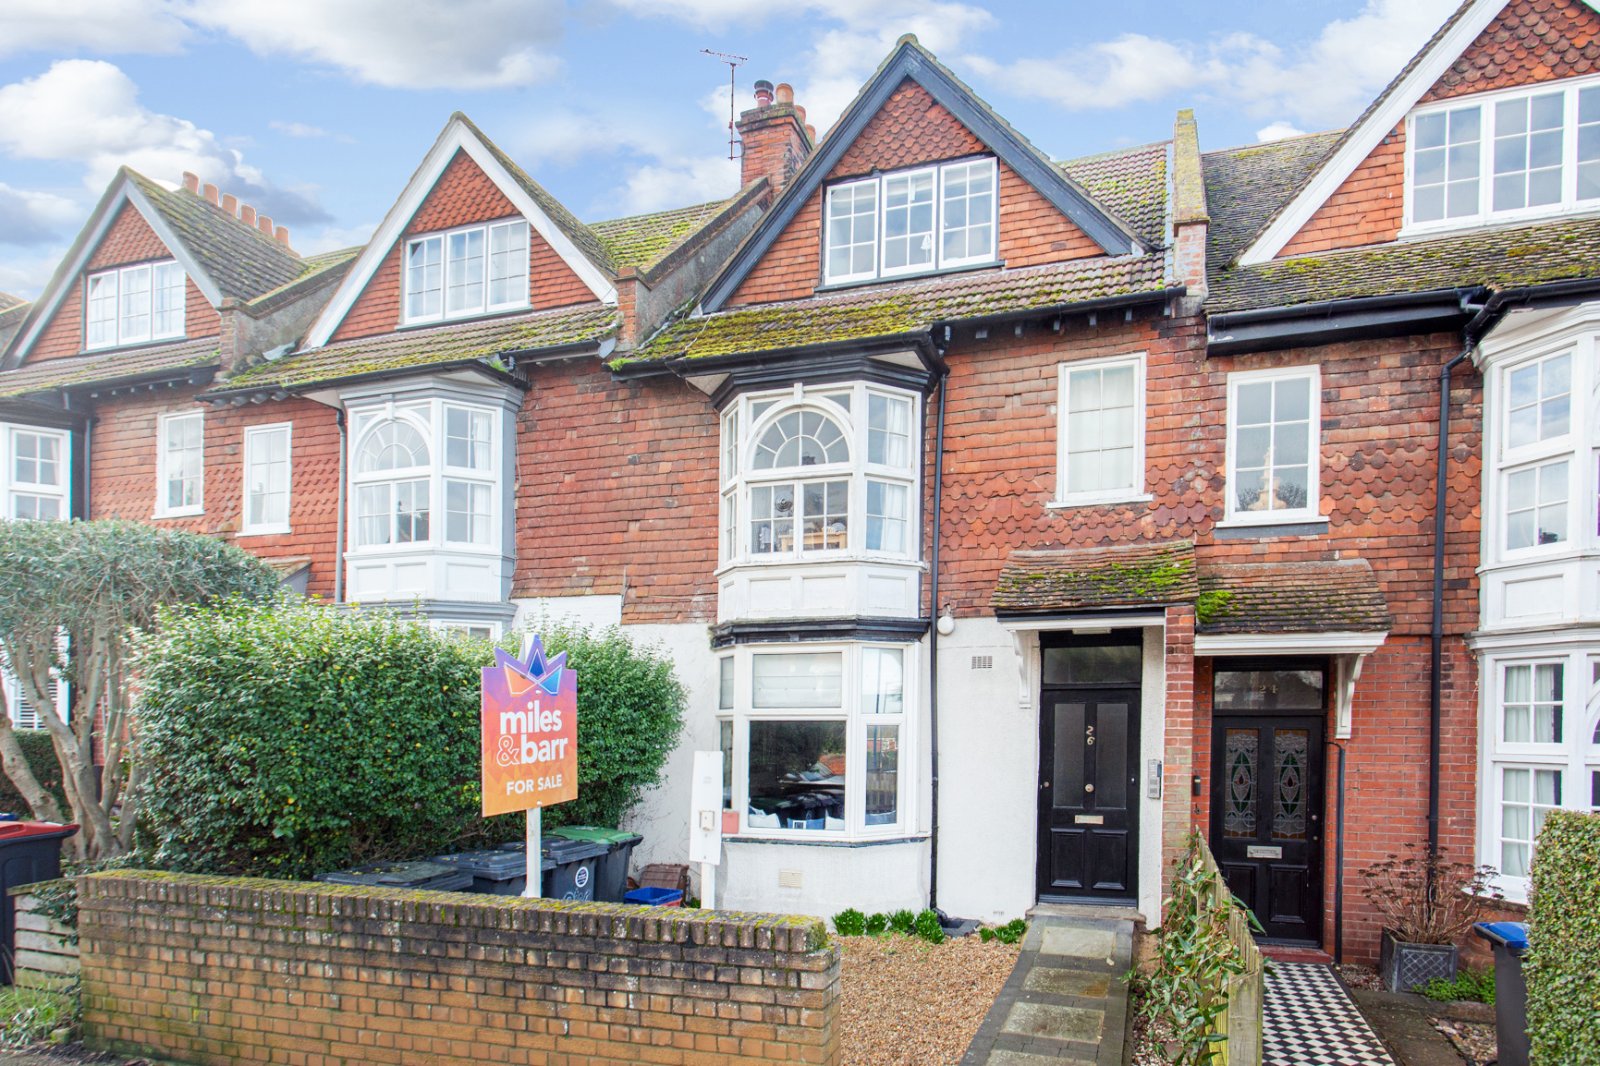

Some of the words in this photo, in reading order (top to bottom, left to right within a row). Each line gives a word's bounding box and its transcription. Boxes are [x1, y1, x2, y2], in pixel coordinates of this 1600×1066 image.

[500, 699, 562, 734] miles
[506, 778, 534, 795] FOR
[537, 774, 563, 791] SALE
